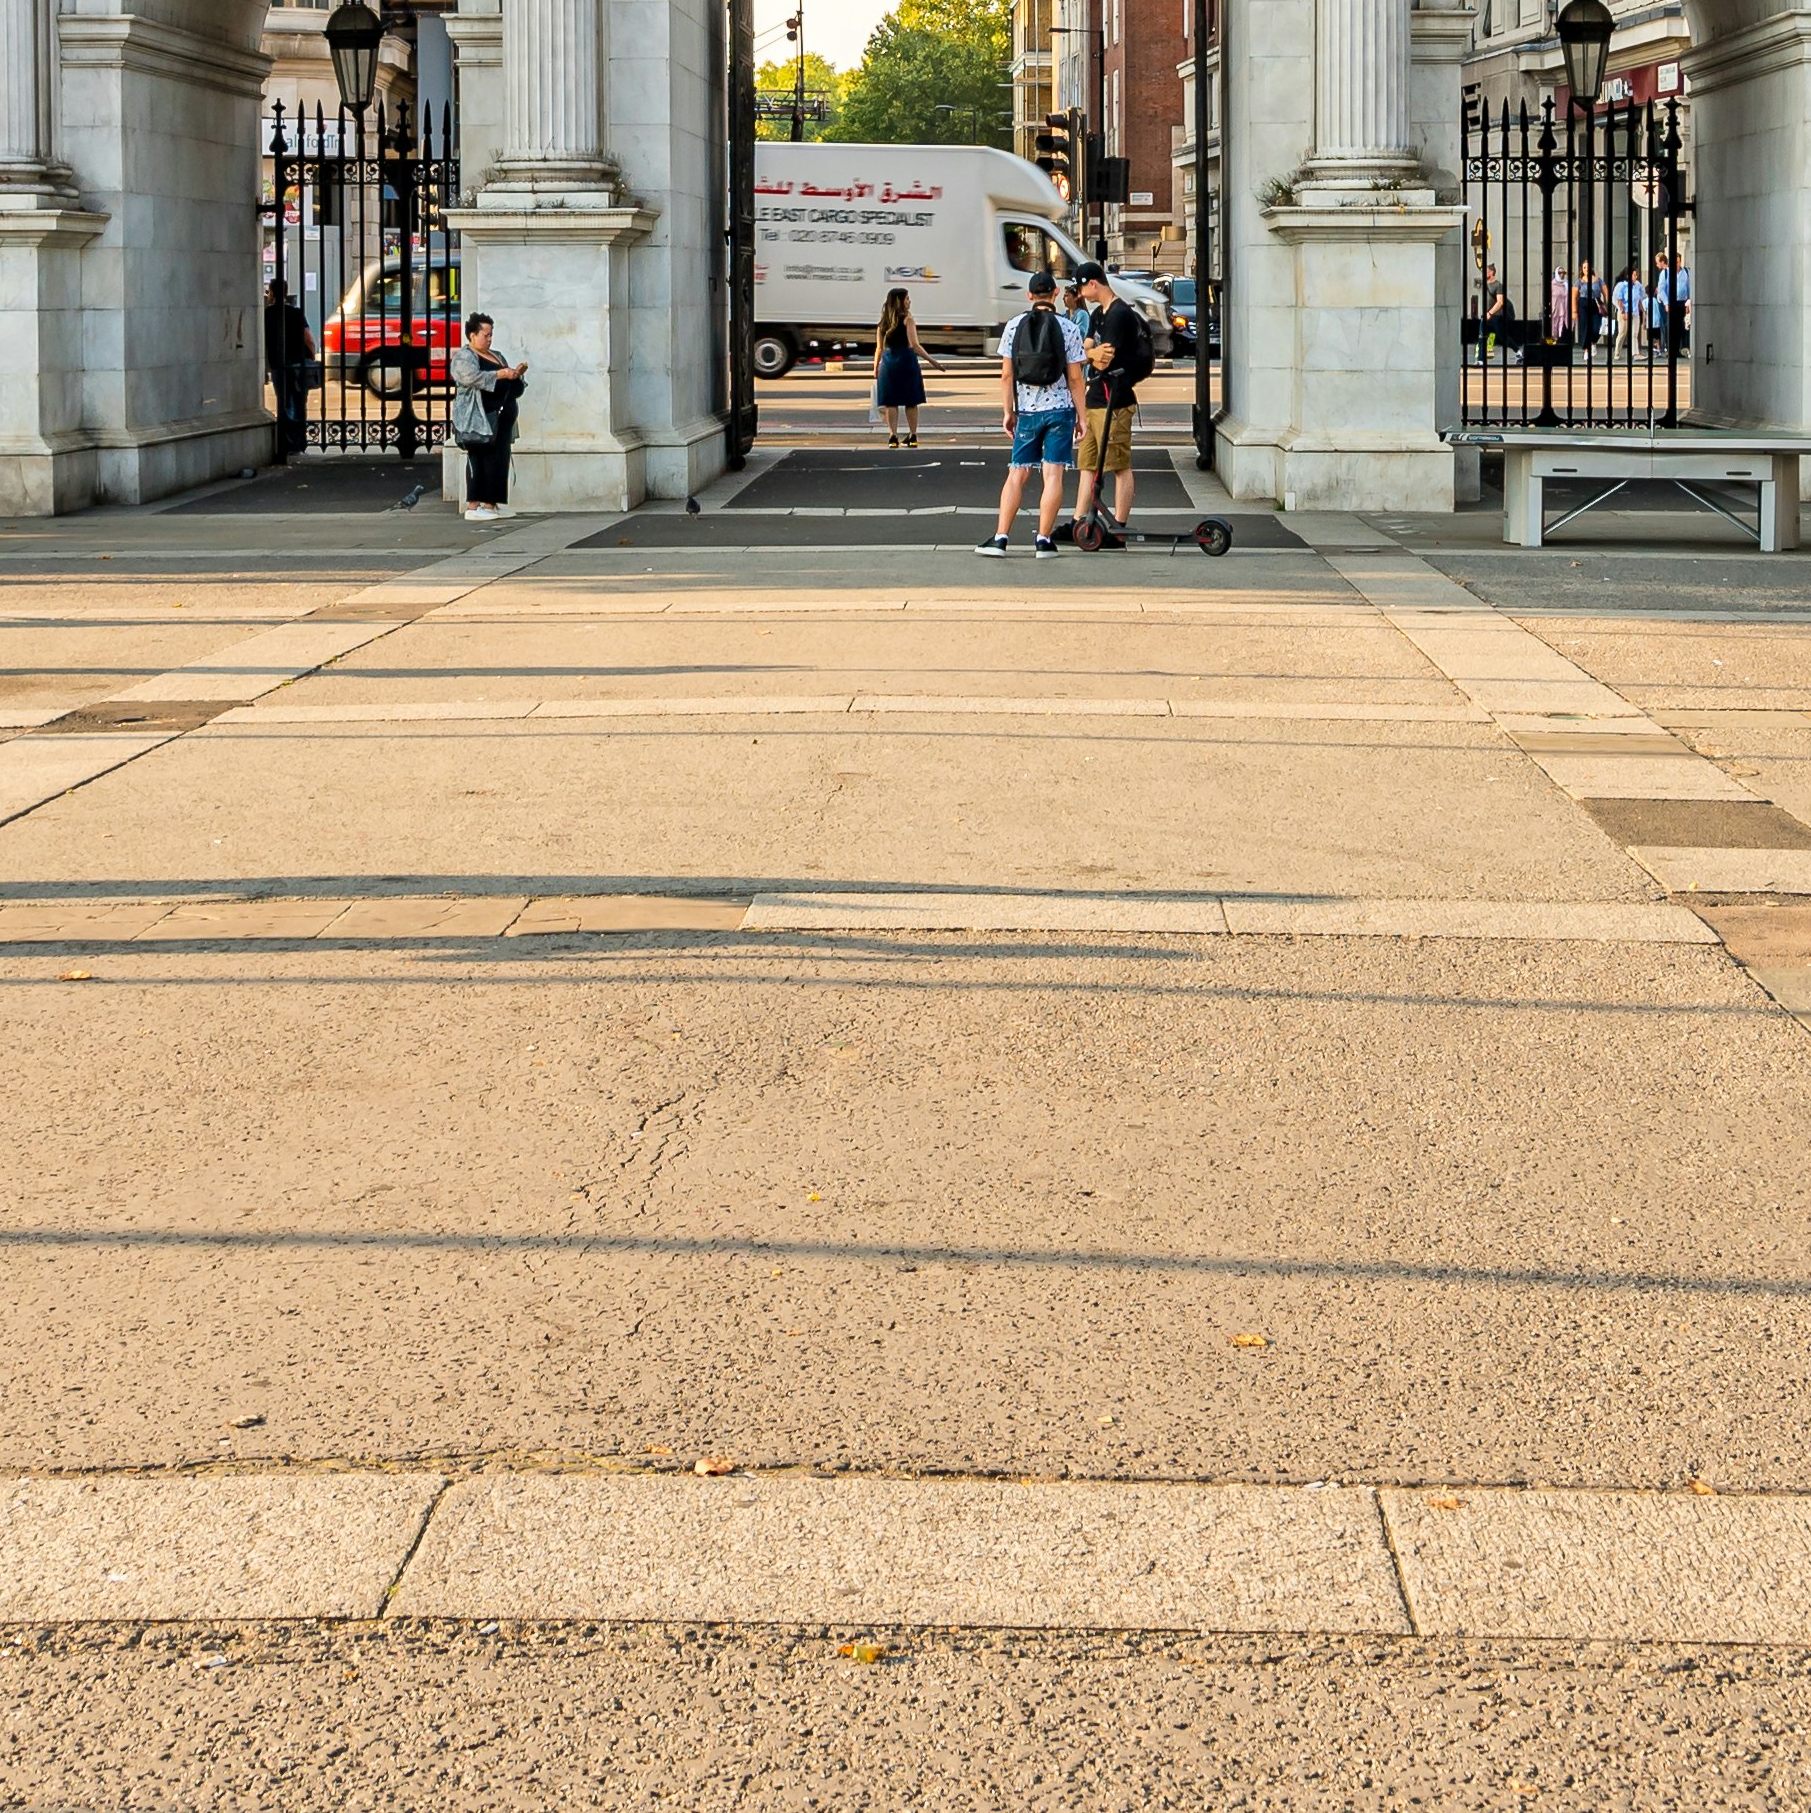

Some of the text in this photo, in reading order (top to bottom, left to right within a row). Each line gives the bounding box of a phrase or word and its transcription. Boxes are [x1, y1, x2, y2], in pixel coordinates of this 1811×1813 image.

[773, 208, 807, 223] EAST
[808, 209, 857, 224] CARGO
[859, 210, 935, 227] SPECIALIST
